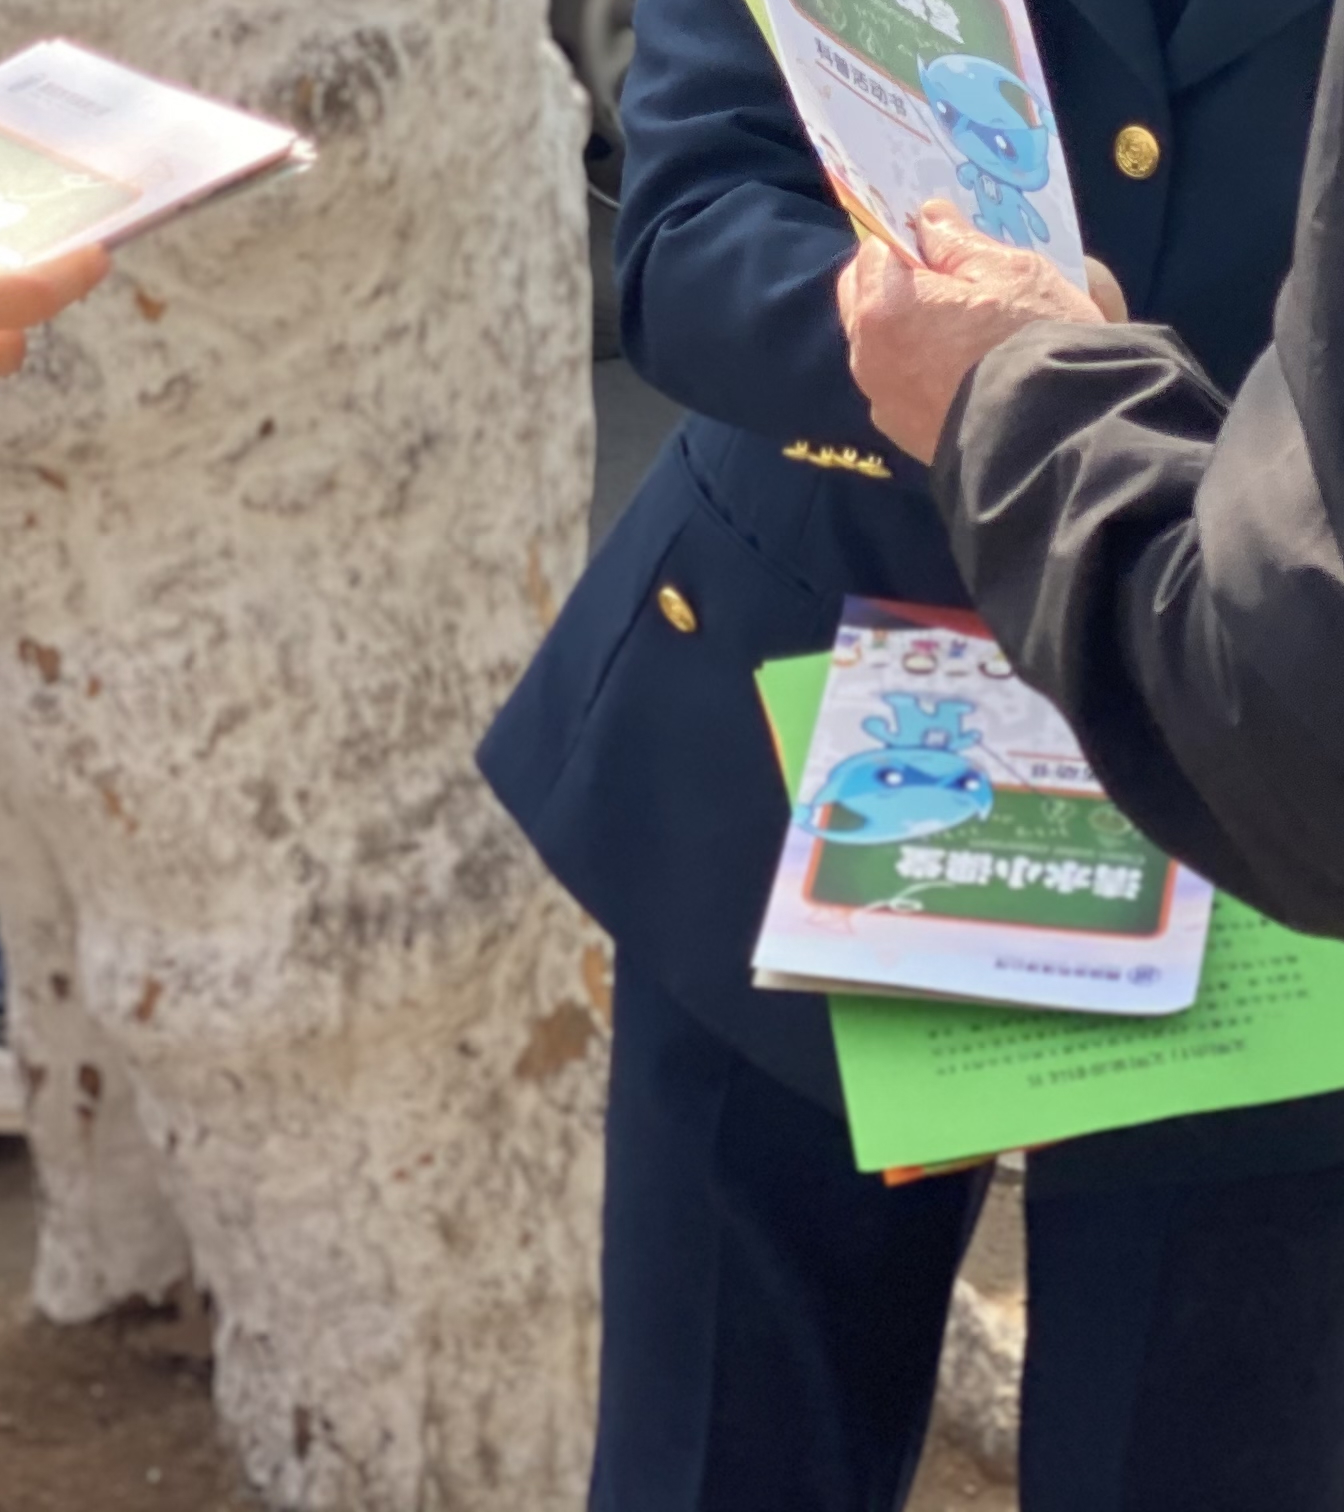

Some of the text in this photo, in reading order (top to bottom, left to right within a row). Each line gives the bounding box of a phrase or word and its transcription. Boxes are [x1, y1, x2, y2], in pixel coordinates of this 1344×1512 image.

[814, 37, 907, 117] 科普活动书
[895, 845, 1144, 902] 清水小课堂
